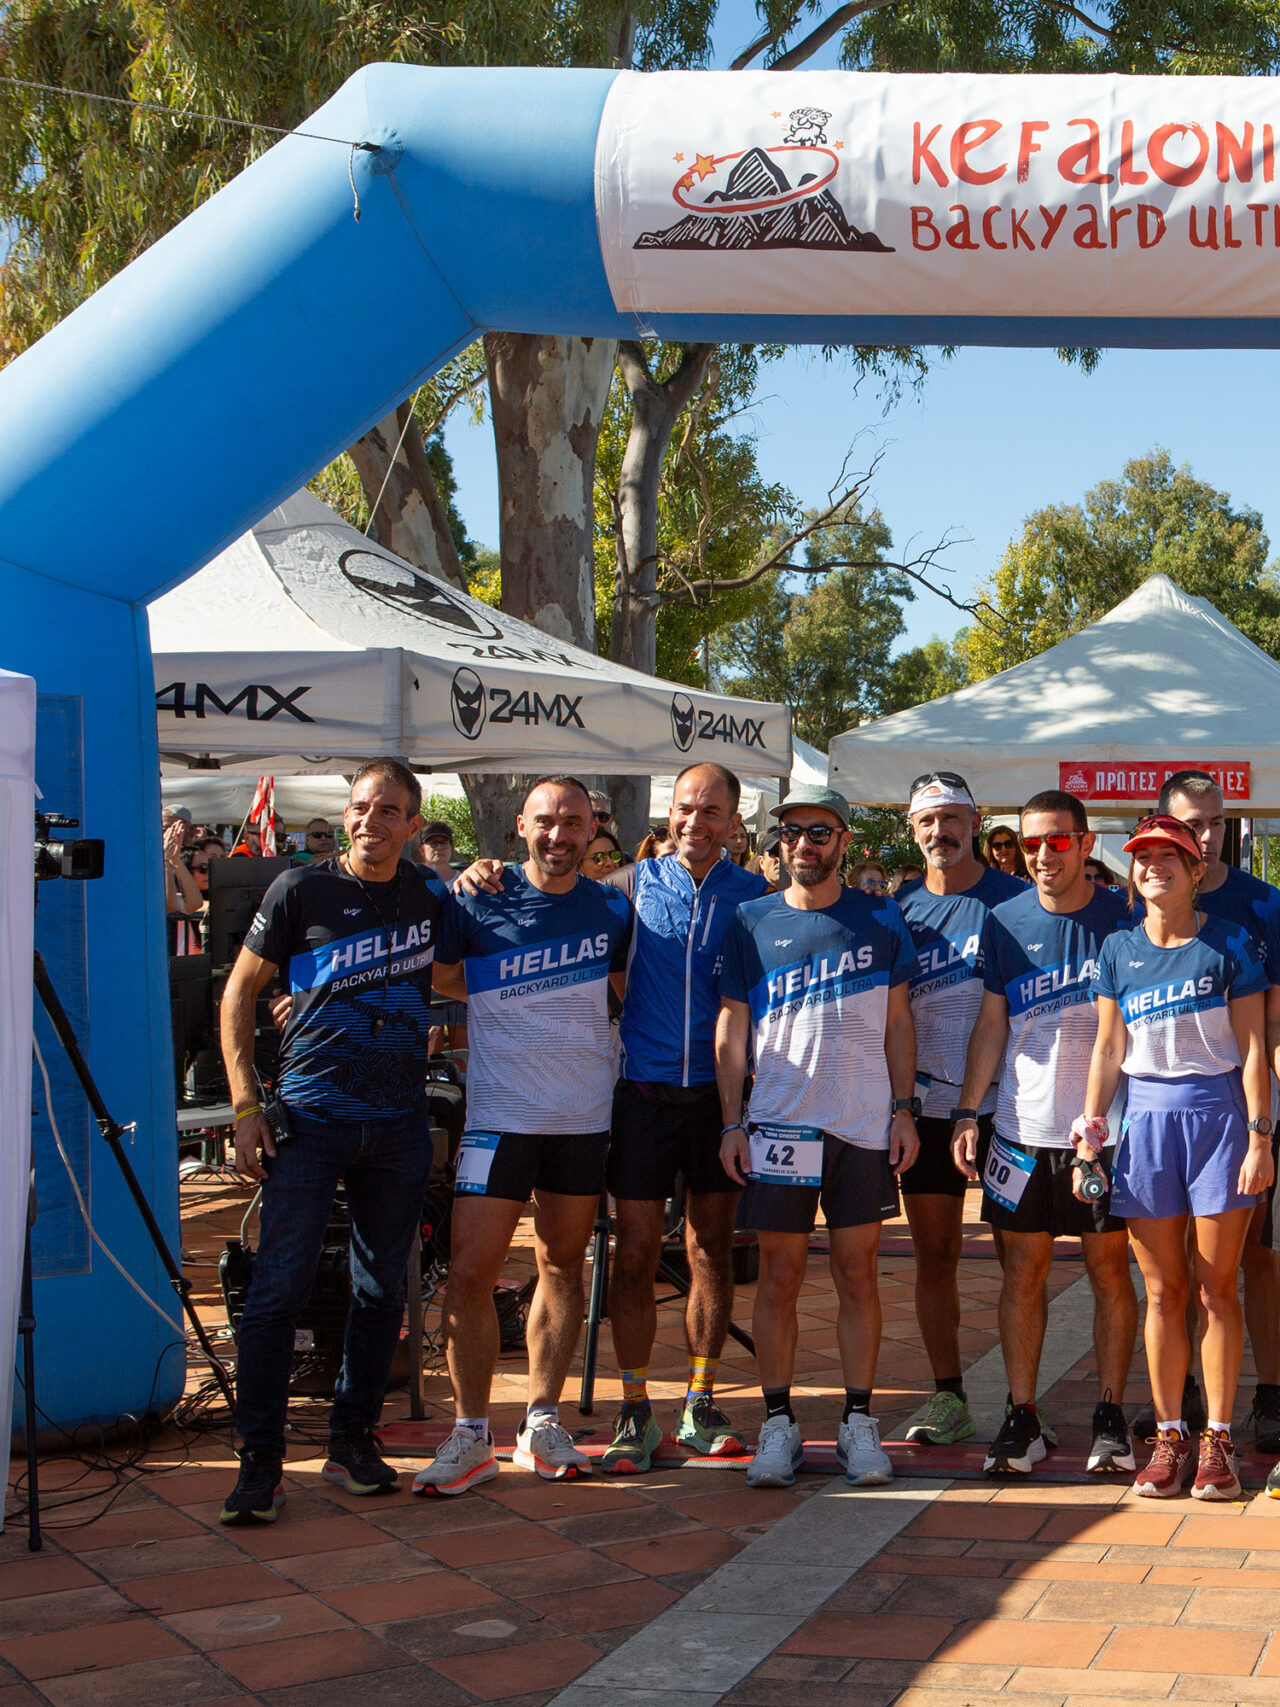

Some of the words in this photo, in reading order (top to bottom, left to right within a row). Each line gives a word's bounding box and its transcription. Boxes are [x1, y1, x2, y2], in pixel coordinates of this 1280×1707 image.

[155, 681, 317, 723] 4MX
[489, 688, 585, 728] 24MX
[697, 710, 766, 749] 24MX
[332, 919, 431, 972] HELLAS
[500, 933, 608, 980] HELLAS
[917, 933, 979, 974] ELLA
[500, 975, 568, 1000] BACKYARD
[768, 945, 873, 1003] HELLAS
[910, 973, 957, 999] CKYARD
[1020, 959, 1095, 1004] HELLA
[769, 990, 831, 1024] BACKYARD
[835, 978, 873, 997] ULTRA
[1127, 976, 1213, 1017] HELLAS
[1179, 1000, 1211, 1014] ULTRA
[766, 1144, 795, 1166] 42
